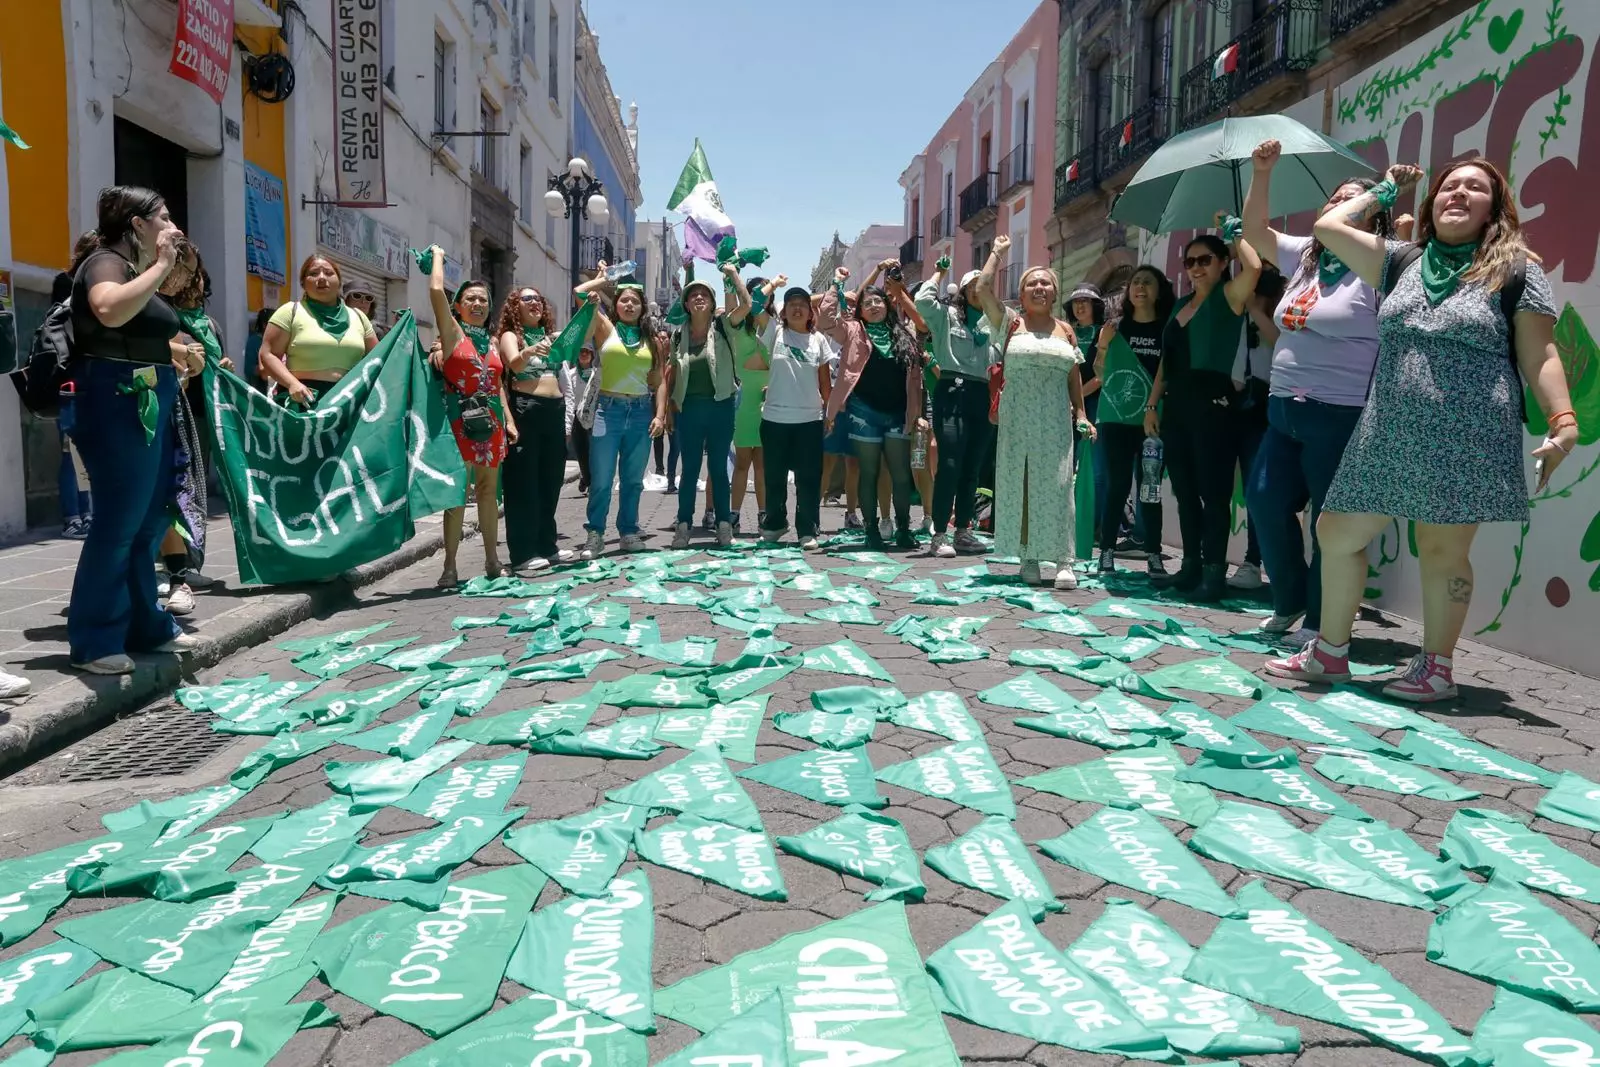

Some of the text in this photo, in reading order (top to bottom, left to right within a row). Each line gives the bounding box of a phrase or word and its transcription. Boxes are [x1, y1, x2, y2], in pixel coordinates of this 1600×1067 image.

[176, 39, 199, 72] 222
[199, 54, 212, 82] 413
[358, 20, 377, 54] 79
[340, 71, 357, 99] DE
[360, 63, 378, 102] 413
[342, 107, 358, 173] RENTA
[362, 111, 378, 160] 222
[1130, 336, 1156, 346] FUCK
[212, 356, 389, 465] ABORTO
[954, 948, 1052, 1016] BRAVO
[983, 913, 1122, 1033] PALMAR DE
[1247, 910, 1471, 1054] NOPALUCAN
